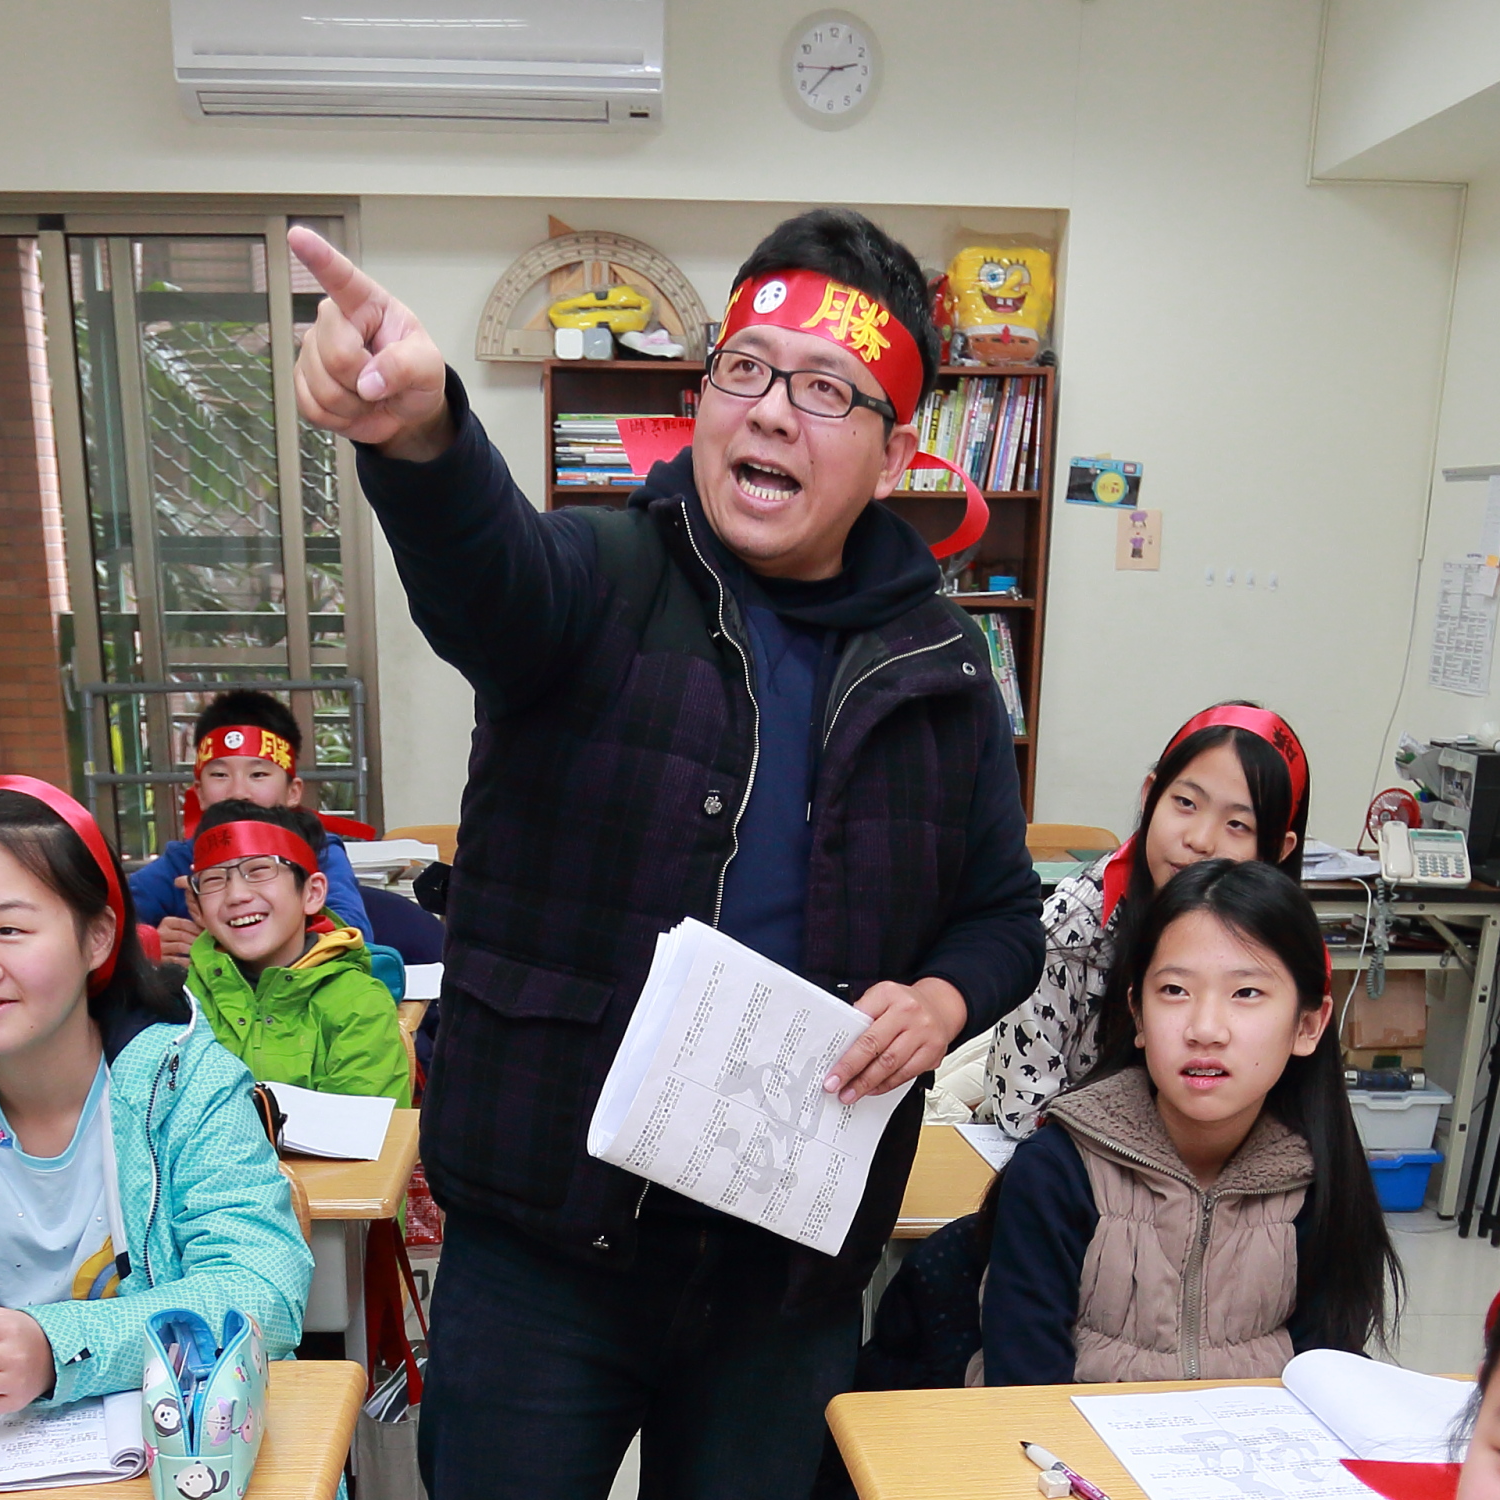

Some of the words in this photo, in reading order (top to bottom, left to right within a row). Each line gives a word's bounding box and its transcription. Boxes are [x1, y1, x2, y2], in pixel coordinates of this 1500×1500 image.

[814, 32, 823, 43] 11
[830, 27, 840, 38] 12
[801, 44, 812, 55] 10
[858, 47, 865, 58] 2
[861, 65, 868, 76] 3
